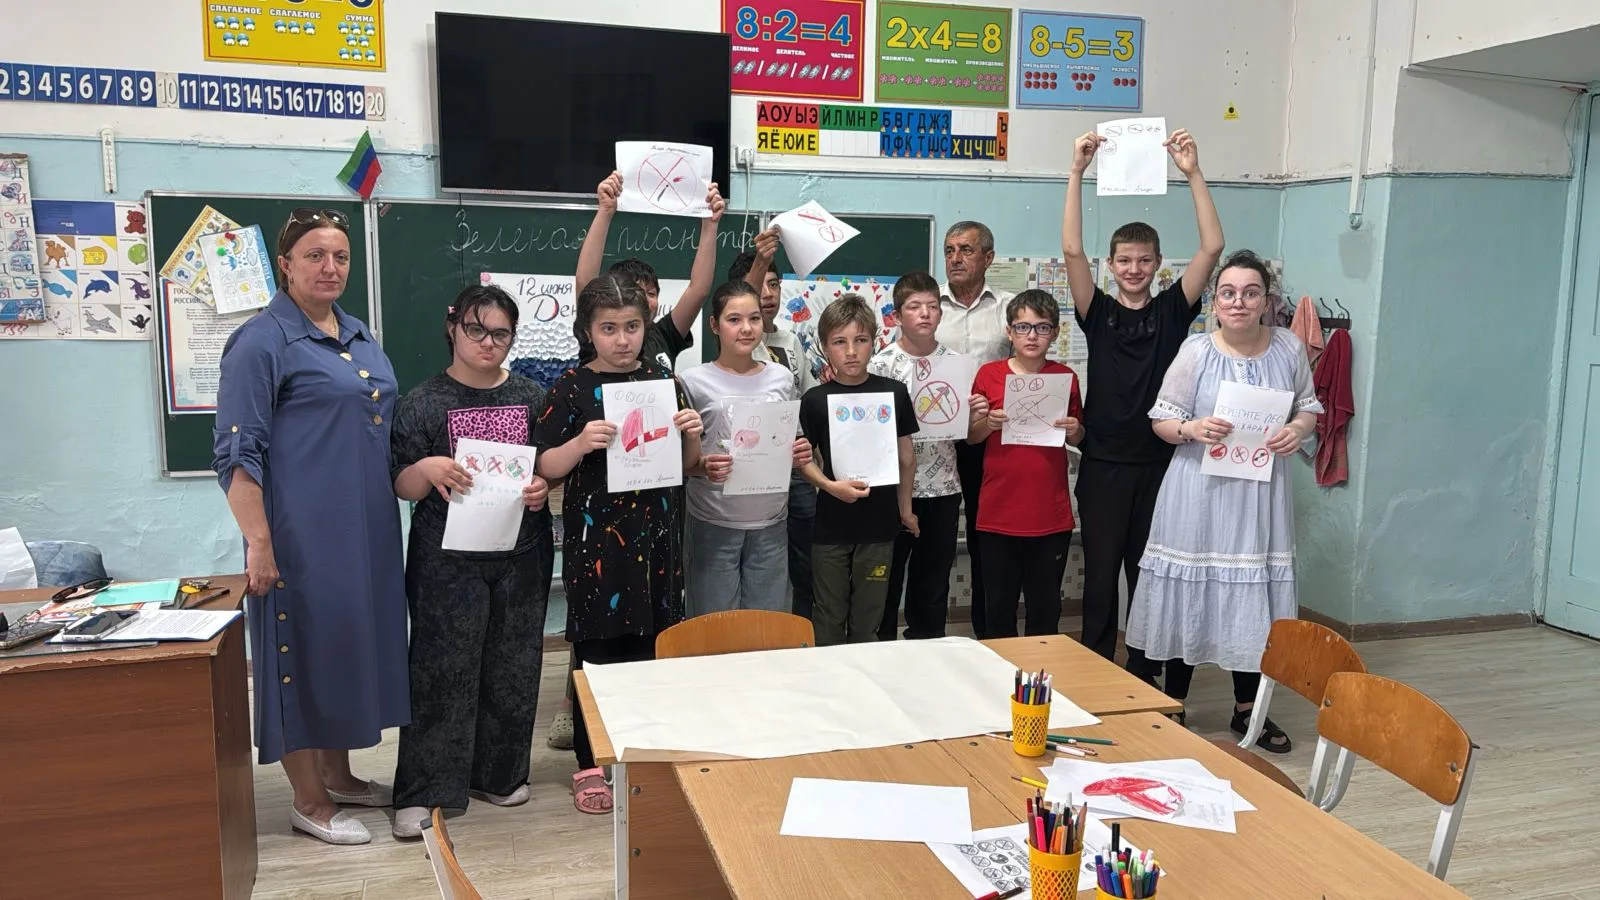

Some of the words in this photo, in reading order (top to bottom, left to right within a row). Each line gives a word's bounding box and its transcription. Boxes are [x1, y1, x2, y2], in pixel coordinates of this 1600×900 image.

[209, 4, 262, 15] СЛАГАЕМОЕ
[269, 8, 321, 19] СЛАГАЕМОЕ
[345, 14, 374, 23] СУММА
[17, 70, 31, 96] 3
[37, 71, 53, 97] 4
[59, 72, 72, 98] 5
[79, 73, 93, 99] 6
[99, 75, 113, 100] 7
[120, 75, 134, 100] 8
[139, 76, 154, 101] 9
[158, 78, 178, 104] 10
[181, 79, 198, 104] 11
[201, 80, 220, 105] 12
[222, 82, 242, 107] 13
[243, 84, 262, 109] 14
[265, 85, 283, 110] 15
[285, 86, 304, 112] 16
[305, 87, 324, 112] 17
[326, 89, 344, 114] 18
[346, 90, 364, 115] 19
[367, 93, 385, 117] 20
[617, 226, 755, 254] планта
[516, 276, 537, 297] 12
[541, 282, 573, 296] июня
